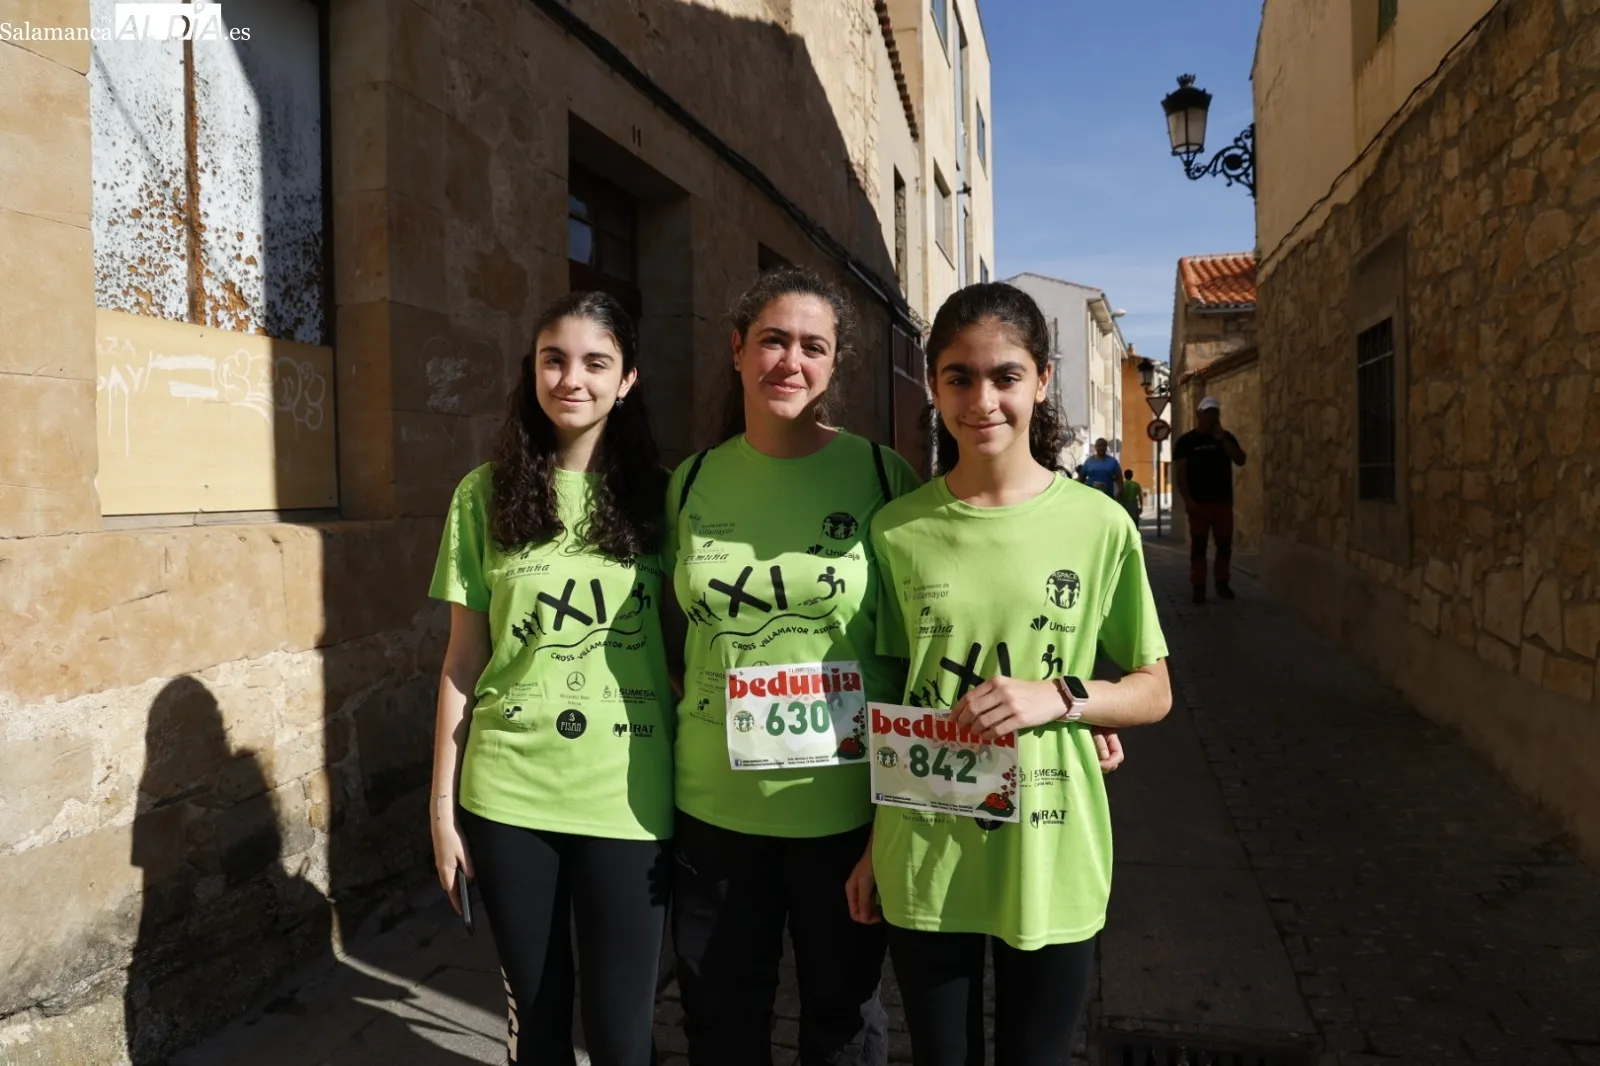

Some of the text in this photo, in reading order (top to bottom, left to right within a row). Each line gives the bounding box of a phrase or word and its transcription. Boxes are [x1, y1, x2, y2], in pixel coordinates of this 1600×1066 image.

[537, 578, 607, 631] XI
[708, 565, 787, 618] XI
[551, 652, 575, 662] CROSS
[577, 640, 623, 660] VILLAMAYOR
[732, 641, 757, 651] CROSS
[759, 626, 809, 648] VILLAMAYOR
[728, 667, 861, 699] bedunia
[766, 700, 830, 736] 630
[872, 709, 1015, 748] beduna
[909, 744, 977, 783] 842
